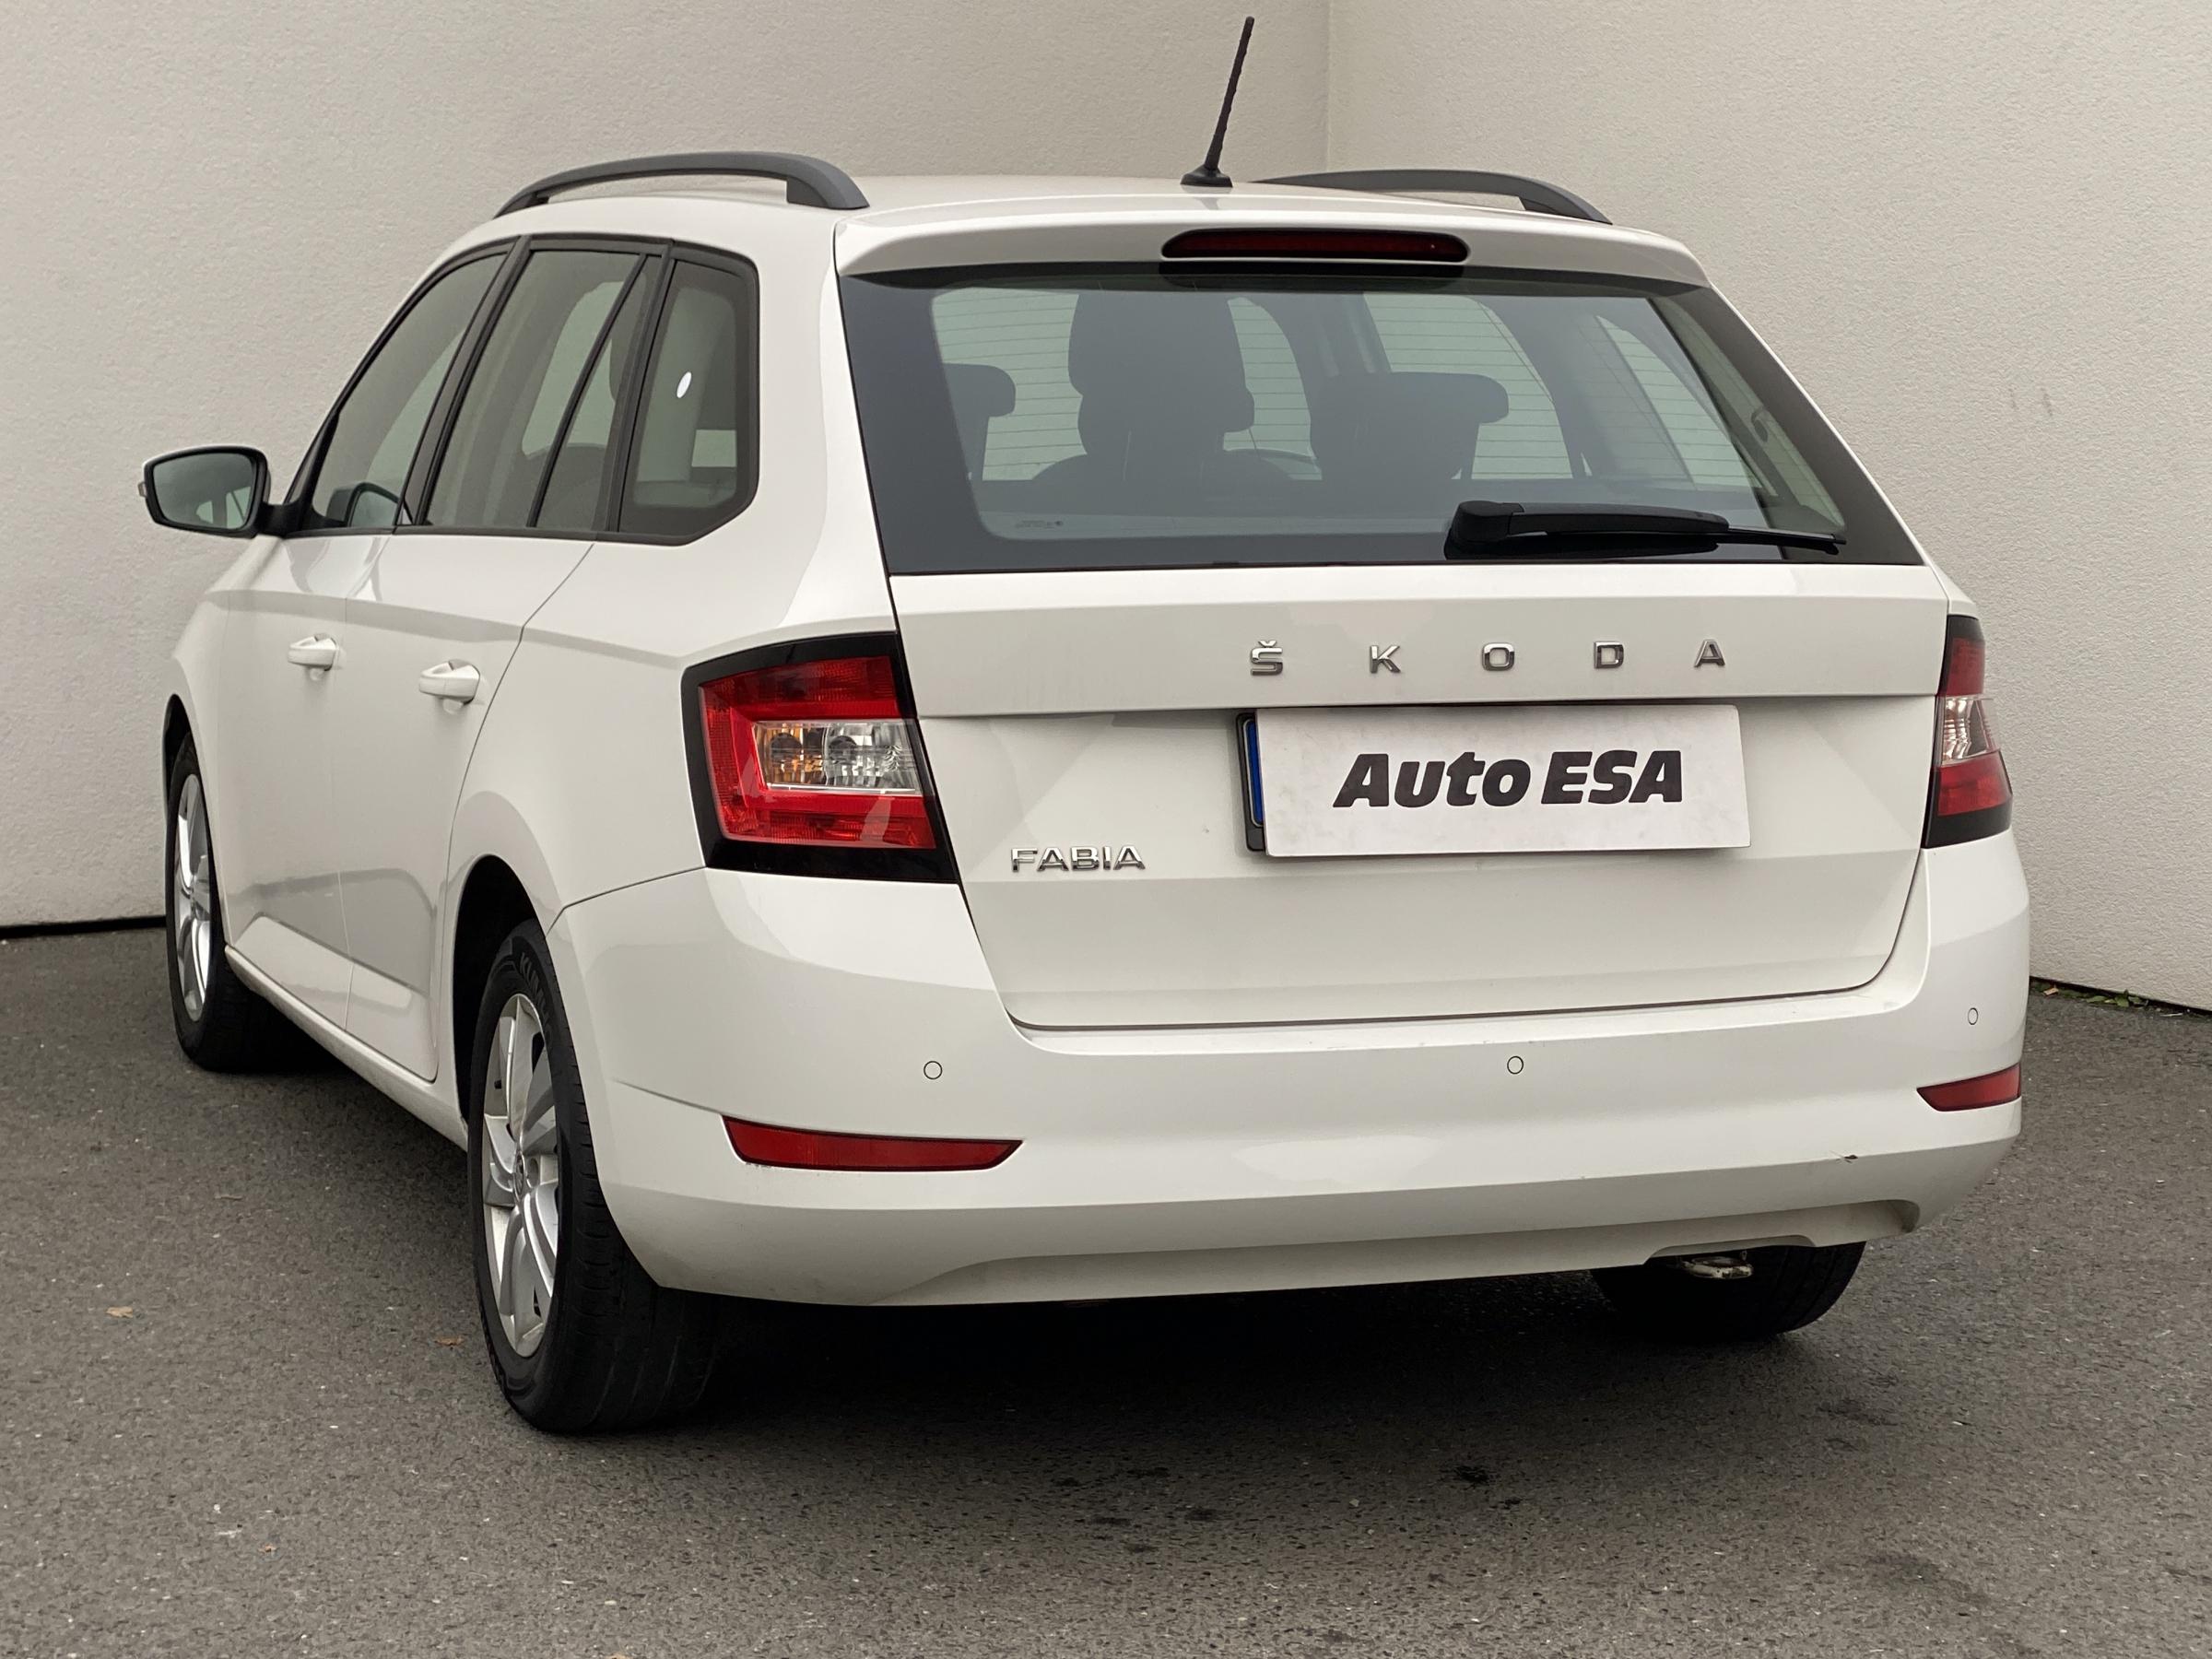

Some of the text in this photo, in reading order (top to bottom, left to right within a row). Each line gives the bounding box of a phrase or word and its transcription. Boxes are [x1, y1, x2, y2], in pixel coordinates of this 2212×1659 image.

[1250, 640, 1725, 676] ŠKODA
[1332, 749, 1683, 807] Auto ESA
[1011, 845, 1146, 873] FABIA
